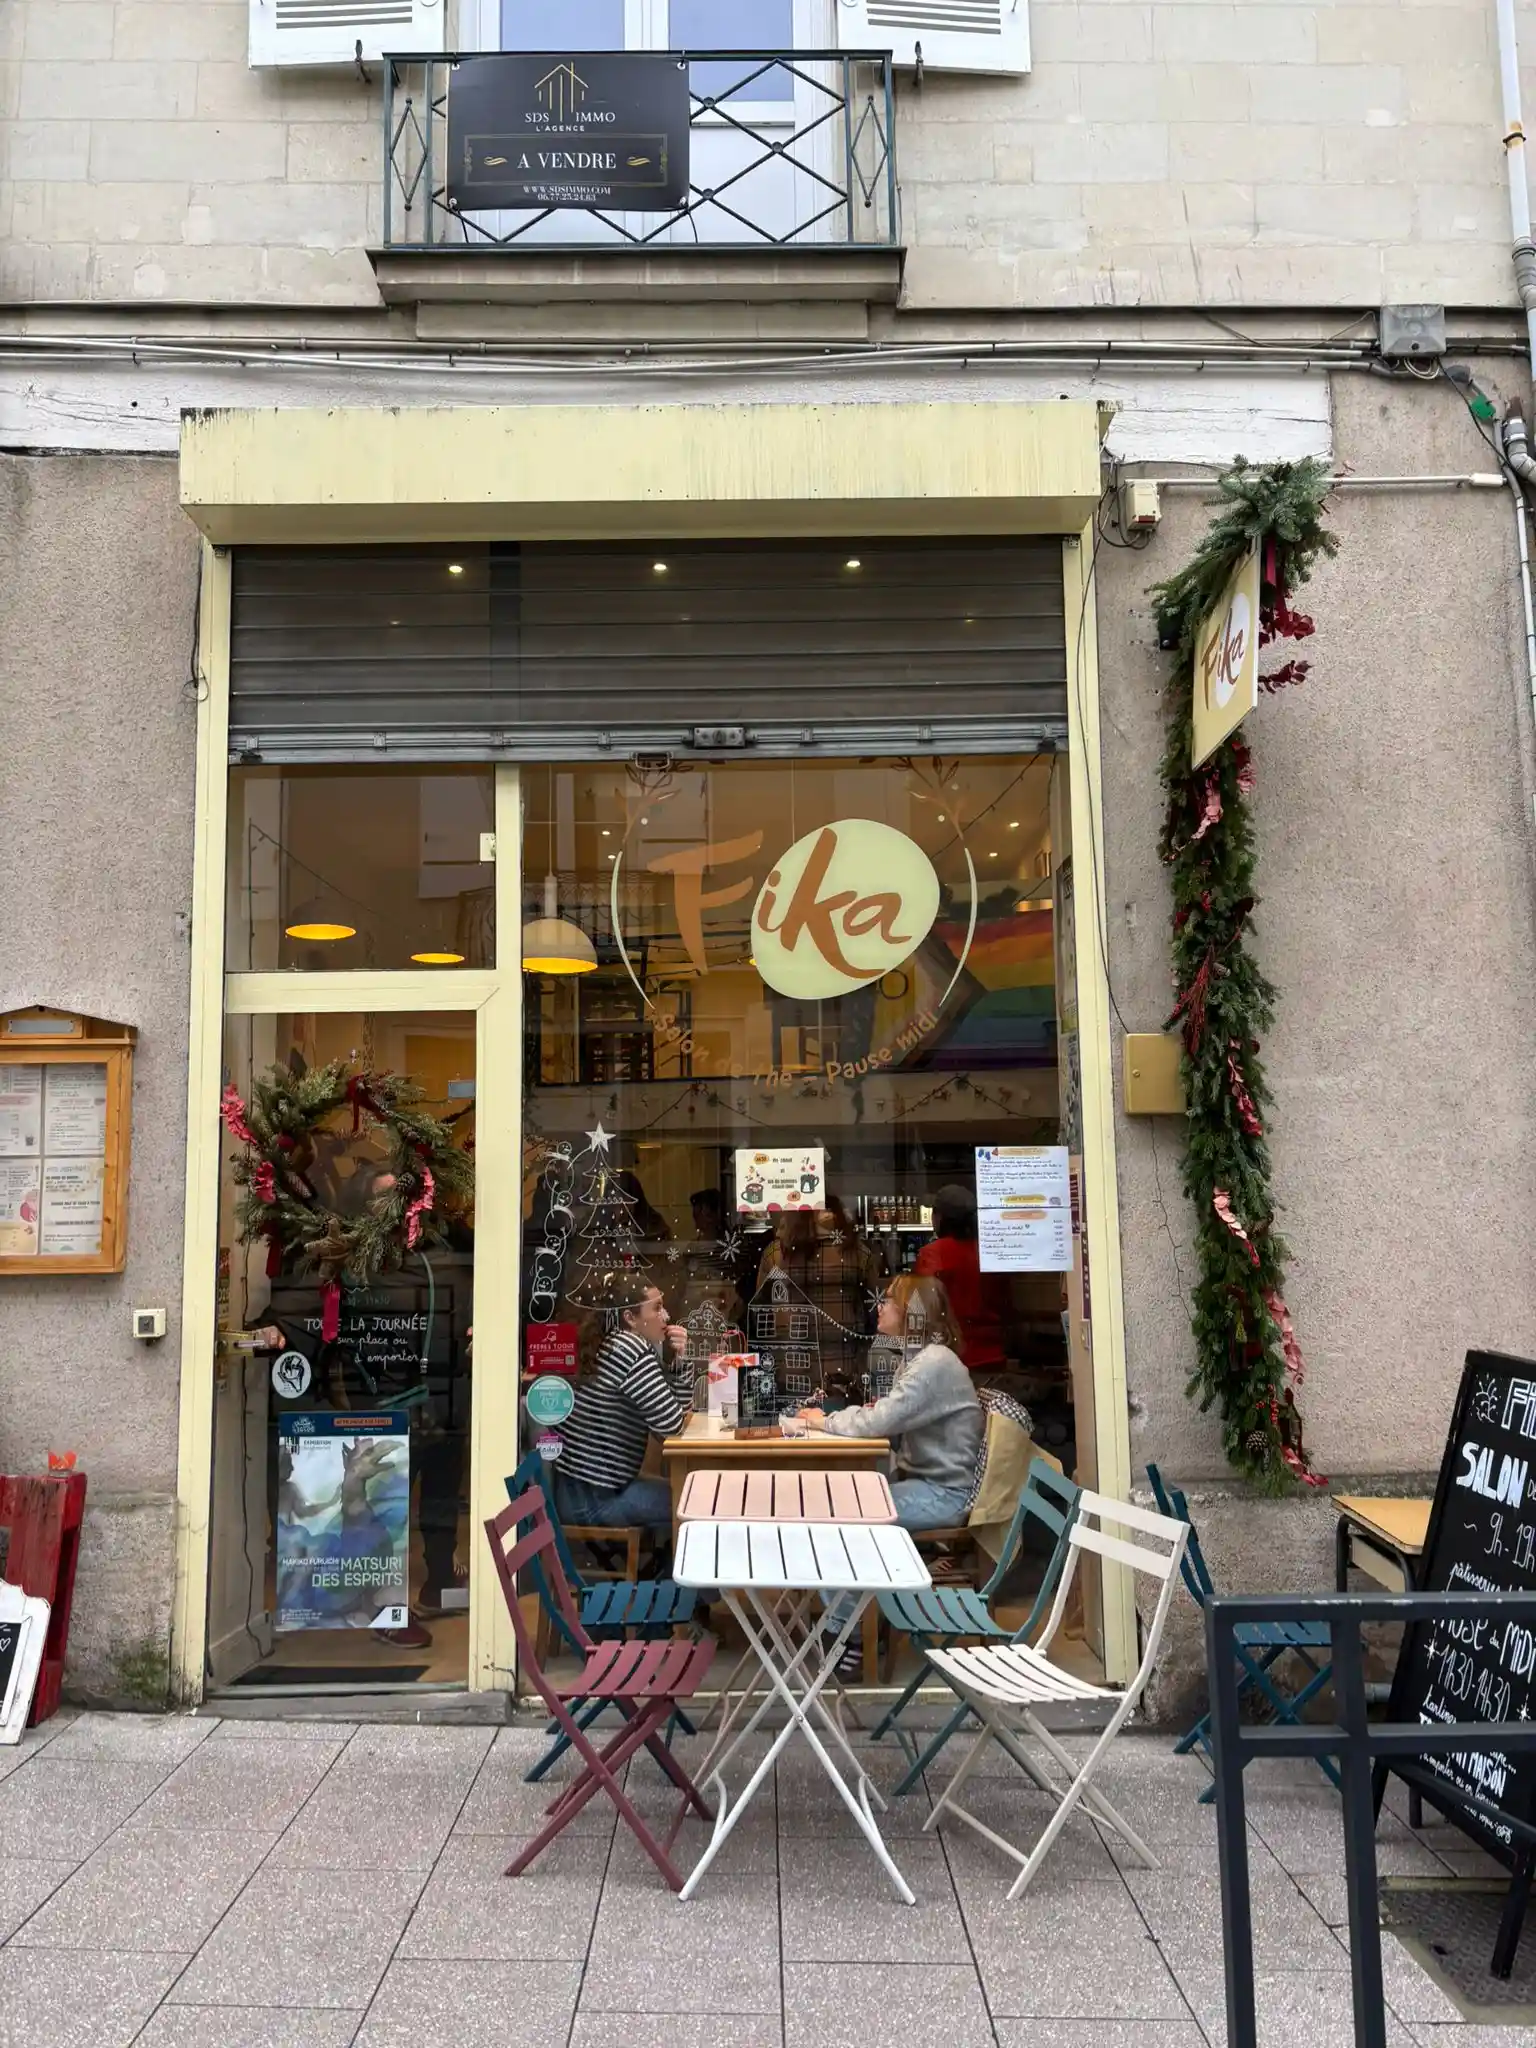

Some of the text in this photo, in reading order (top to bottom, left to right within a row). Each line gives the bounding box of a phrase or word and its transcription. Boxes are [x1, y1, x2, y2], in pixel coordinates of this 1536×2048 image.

[524, 111, 616, 123] SDS IMMO
[535, 124, 585, 132] L'AGENCE
[517, 152, 617, 169] A VENDRE
[1200, 607, 1245, 711] Fika
[646, 827, 912, 981] Fika
[826, 1046, 894, 1085] Pause
[896, 1008, 939, 1051] midi
[304, 1312, 428, 1331] TOE LA JOURNÉE
[359, 1332, 389, 1351] place
[393, 1337, 408, 1345] ou
[367, 1349, 420, 1370] emporter
[1456, 1441, 1528, 1509] SALON
[340, 1556, 402, 1571] MATSURI
[312, 1572, 403, 1587] DES ESPRITS
